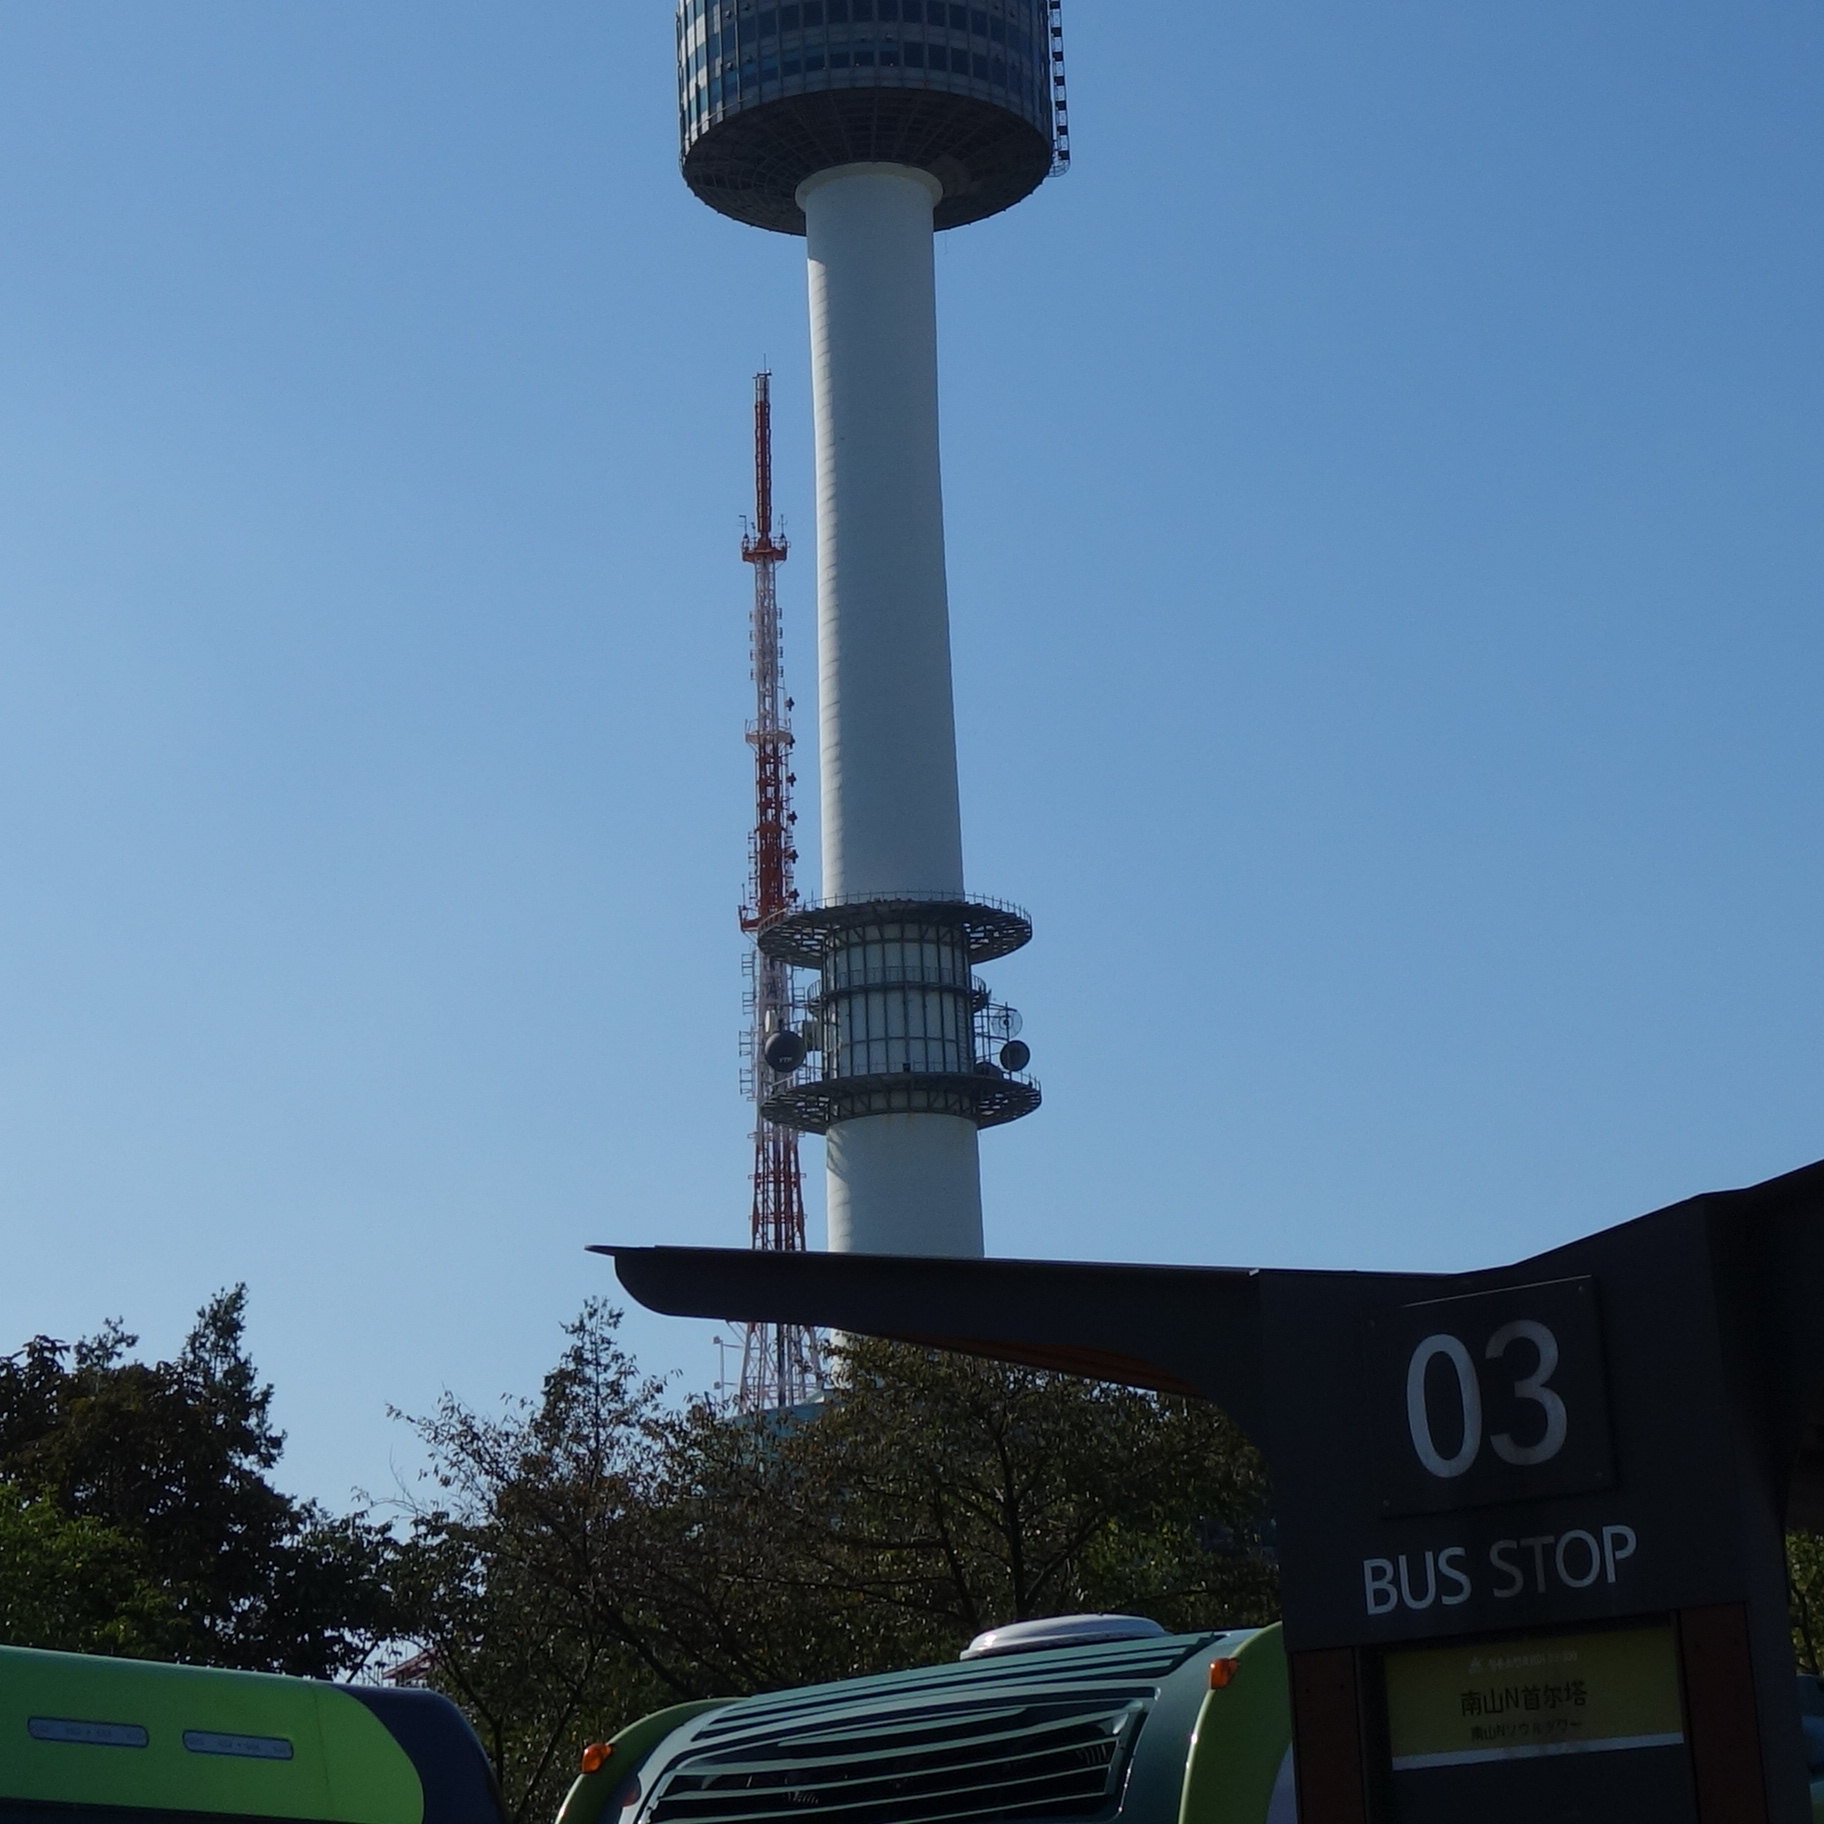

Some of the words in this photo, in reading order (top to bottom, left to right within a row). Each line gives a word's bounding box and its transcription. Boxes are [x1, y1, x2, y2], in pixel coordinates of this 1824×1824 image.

[1406, 1319, 1568, 1478] 03
[1363, 1546, 1473, 1616] BUS
[1489, 1523, 1639, 1599] STOP
[1460, 1680, 1587, 1717] 南山N首尔塔
